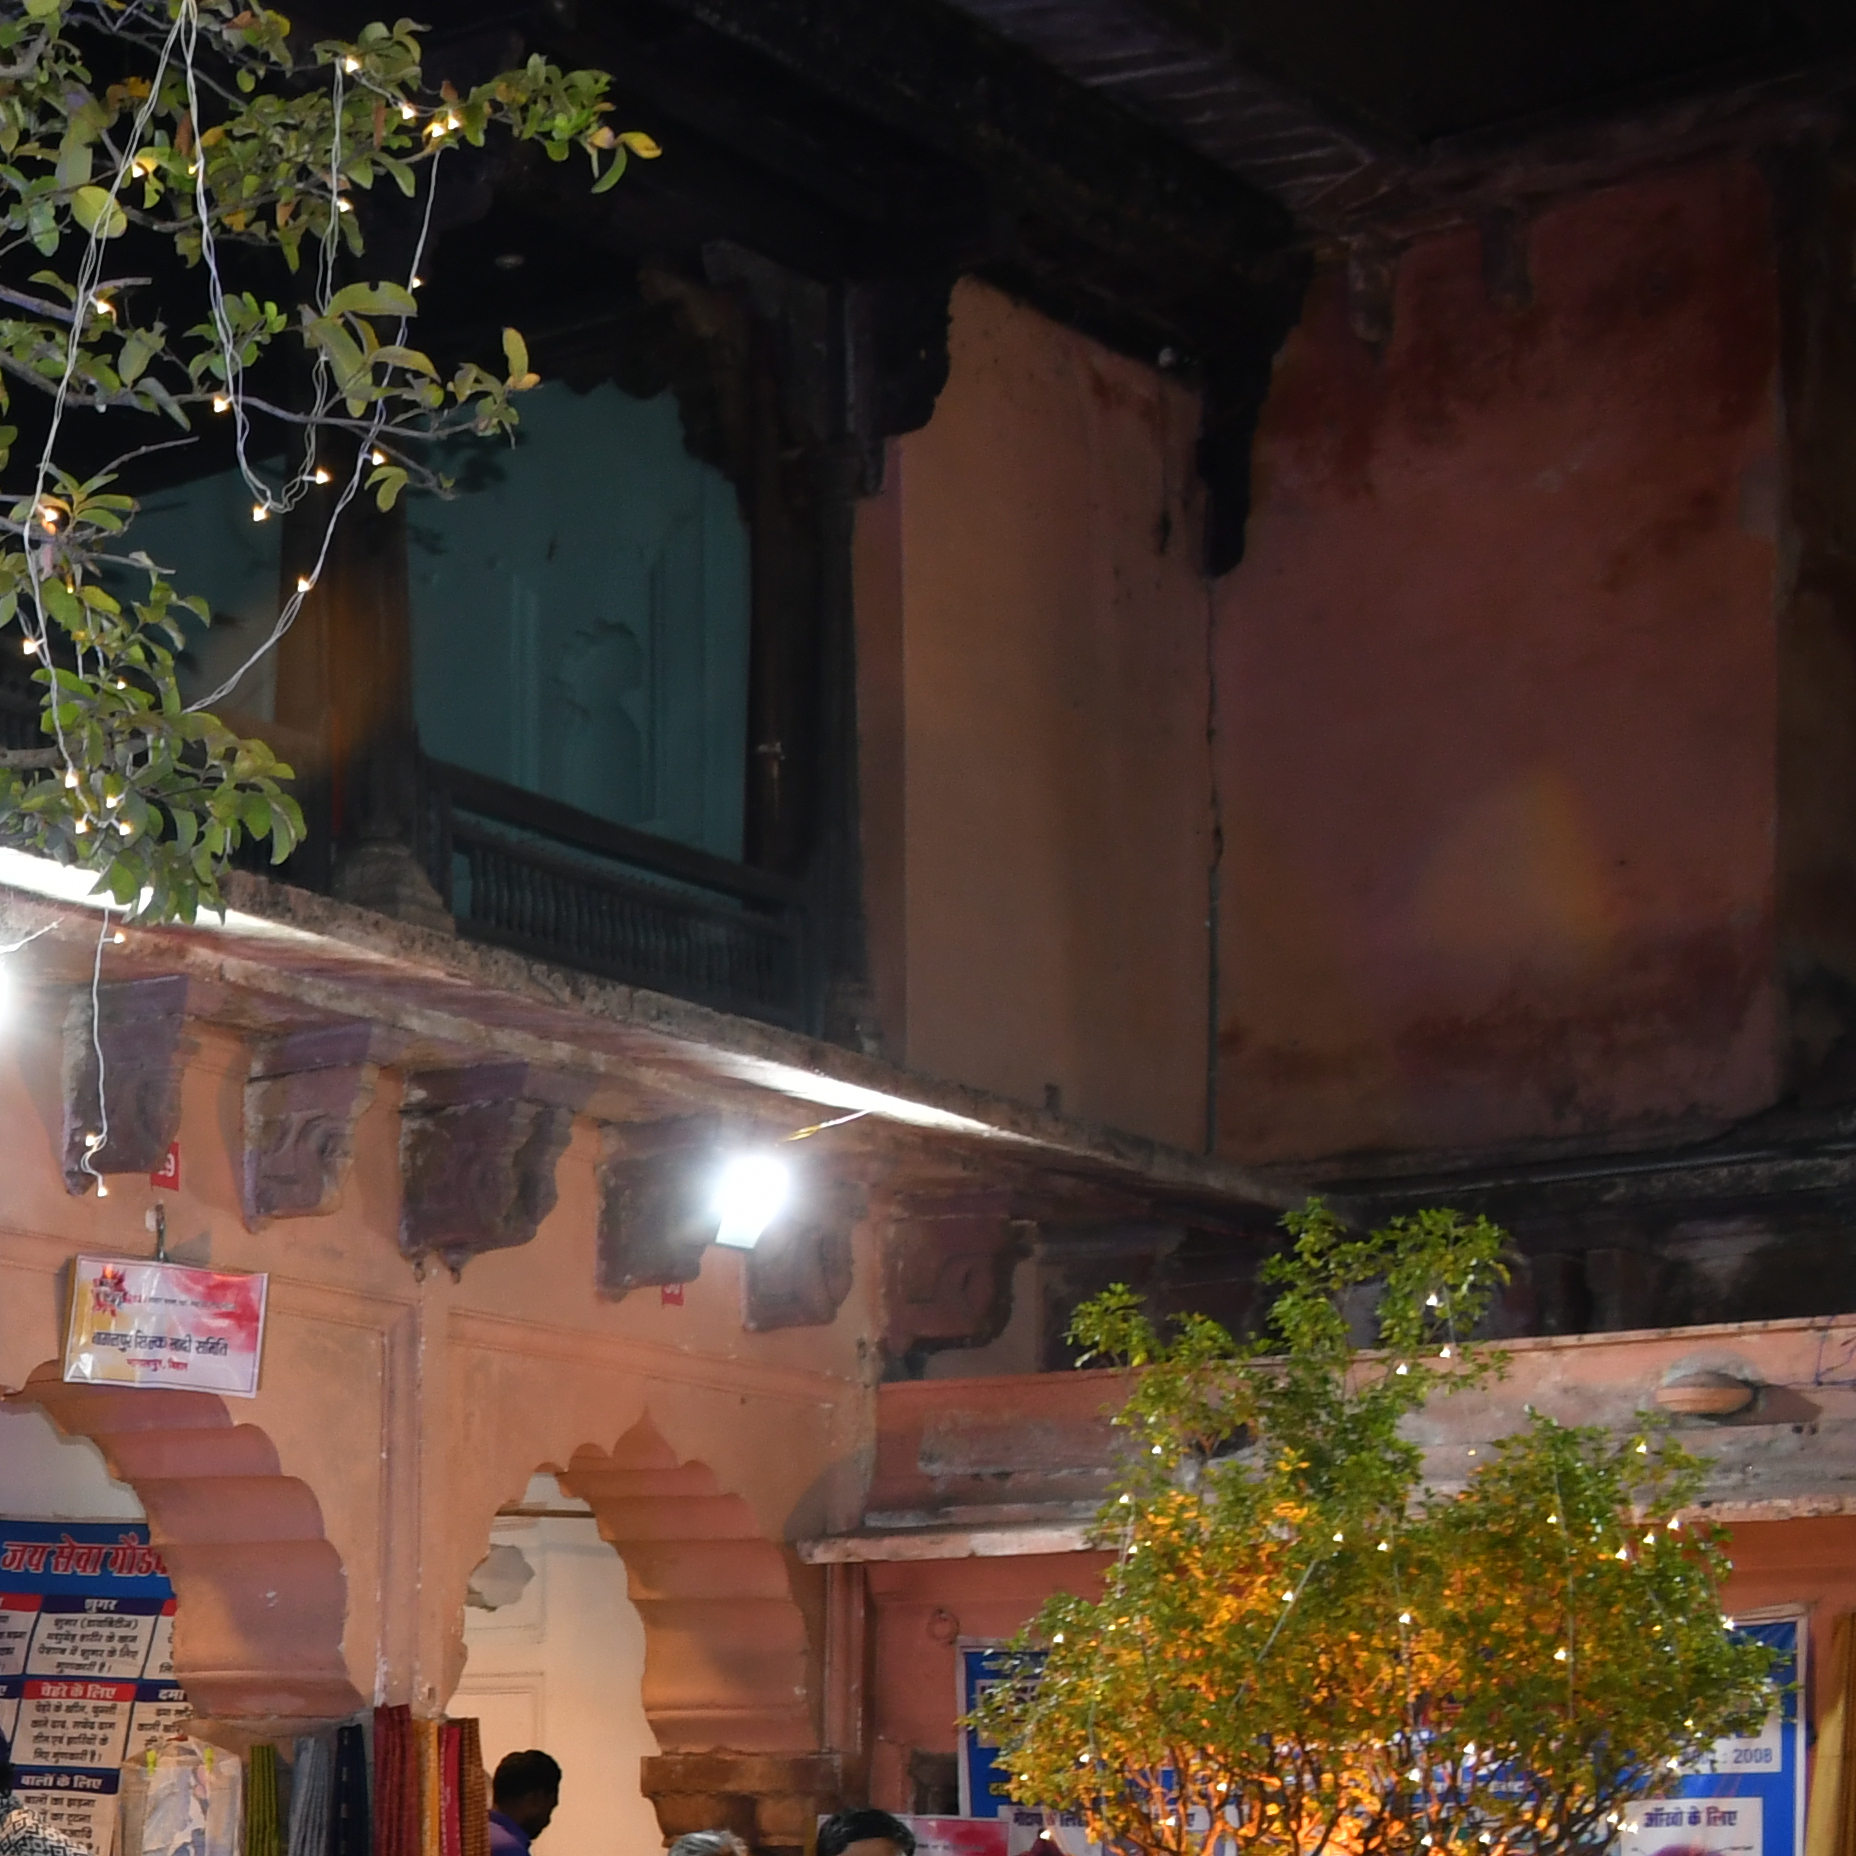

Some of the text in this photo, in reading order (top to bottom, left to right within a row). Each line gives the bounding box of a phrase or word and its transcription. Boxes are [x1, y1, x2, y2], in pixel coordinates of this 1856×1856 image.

[1, 1540, 51, 1573] जय
[51, 1533, 106, 1575] सेवा
[87, 1683, 117, 1699] लिए
[1733, 1747, 1773, 1764] 2008
[56, 1775, 71, 1788] के
[73, 1775, 103, 1790] लिए
